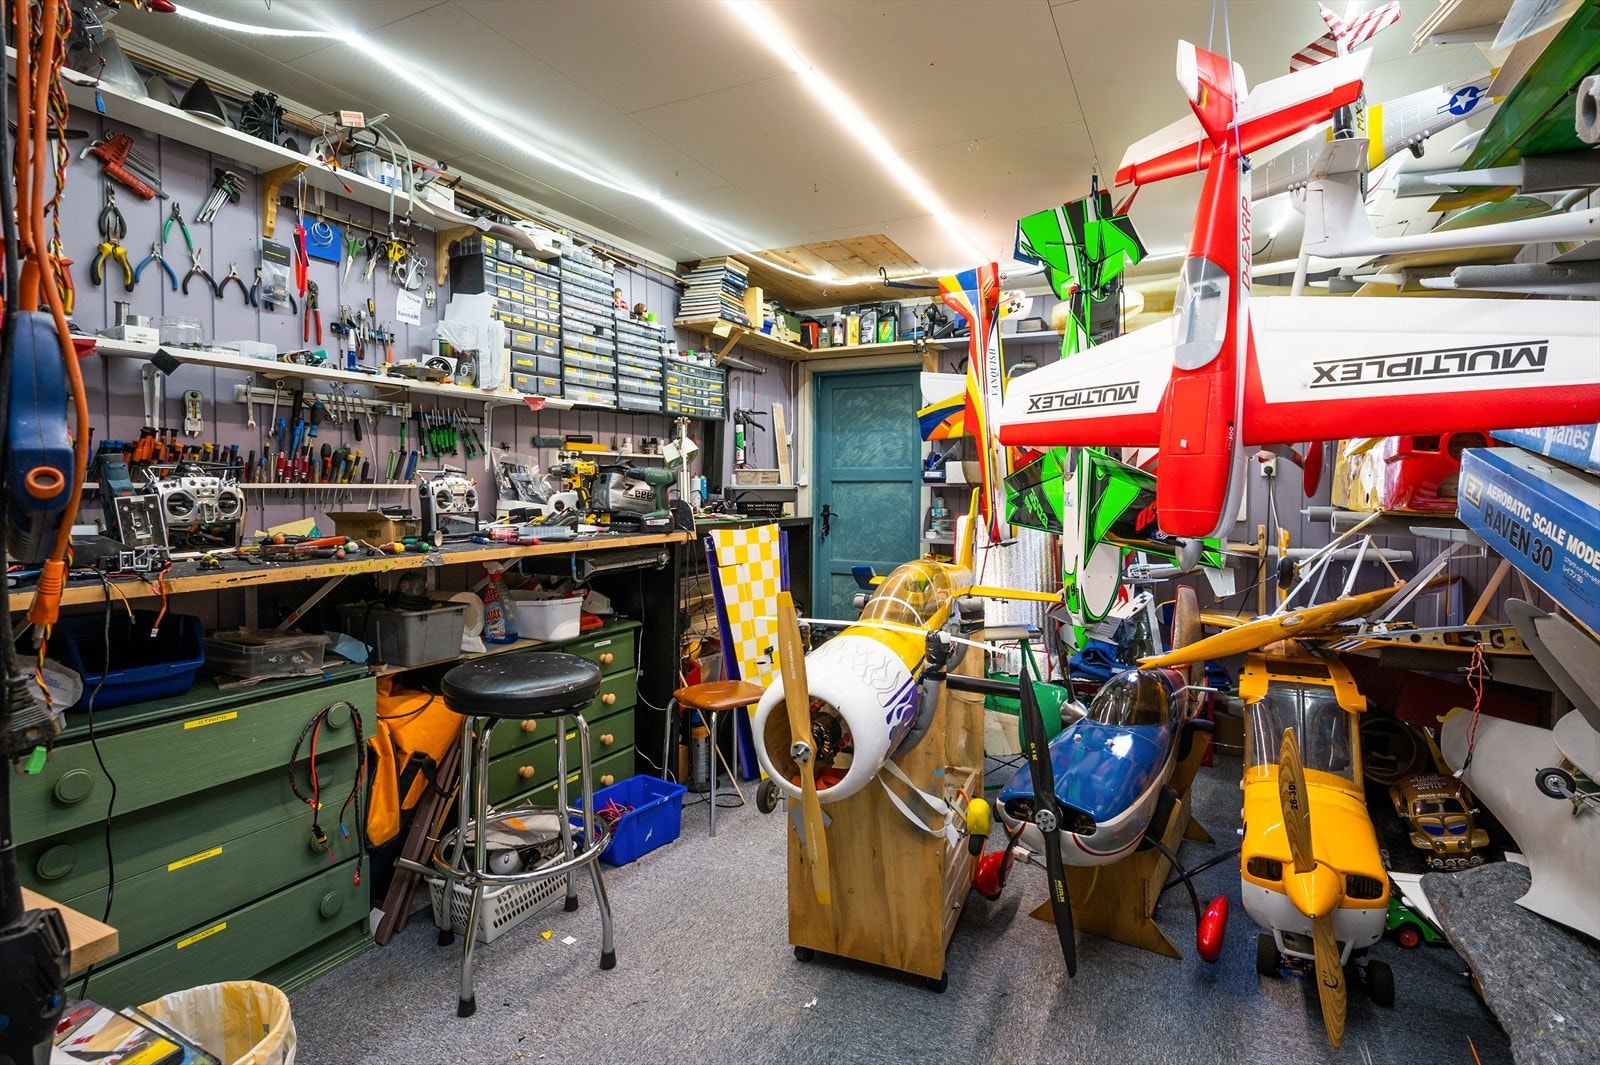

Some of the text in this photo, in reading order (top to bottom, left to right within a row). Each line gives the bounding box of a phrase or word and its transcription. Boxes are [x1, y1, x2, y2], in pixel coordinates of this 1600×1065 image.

[1241, 195, 1253, 293] D-EXRP
[988, 347, 999, 397] VANQUISH
[1313, 345, 1548, 384] MULTIPLEX
[1028, 384, 1140, 412] MULTIPLEX
[1484, 504, 1554, 574] RAVEN 30
[1486, 483, 1531, 522] AEROBATIC
[1532, 512, 1567, 547] SCALE
